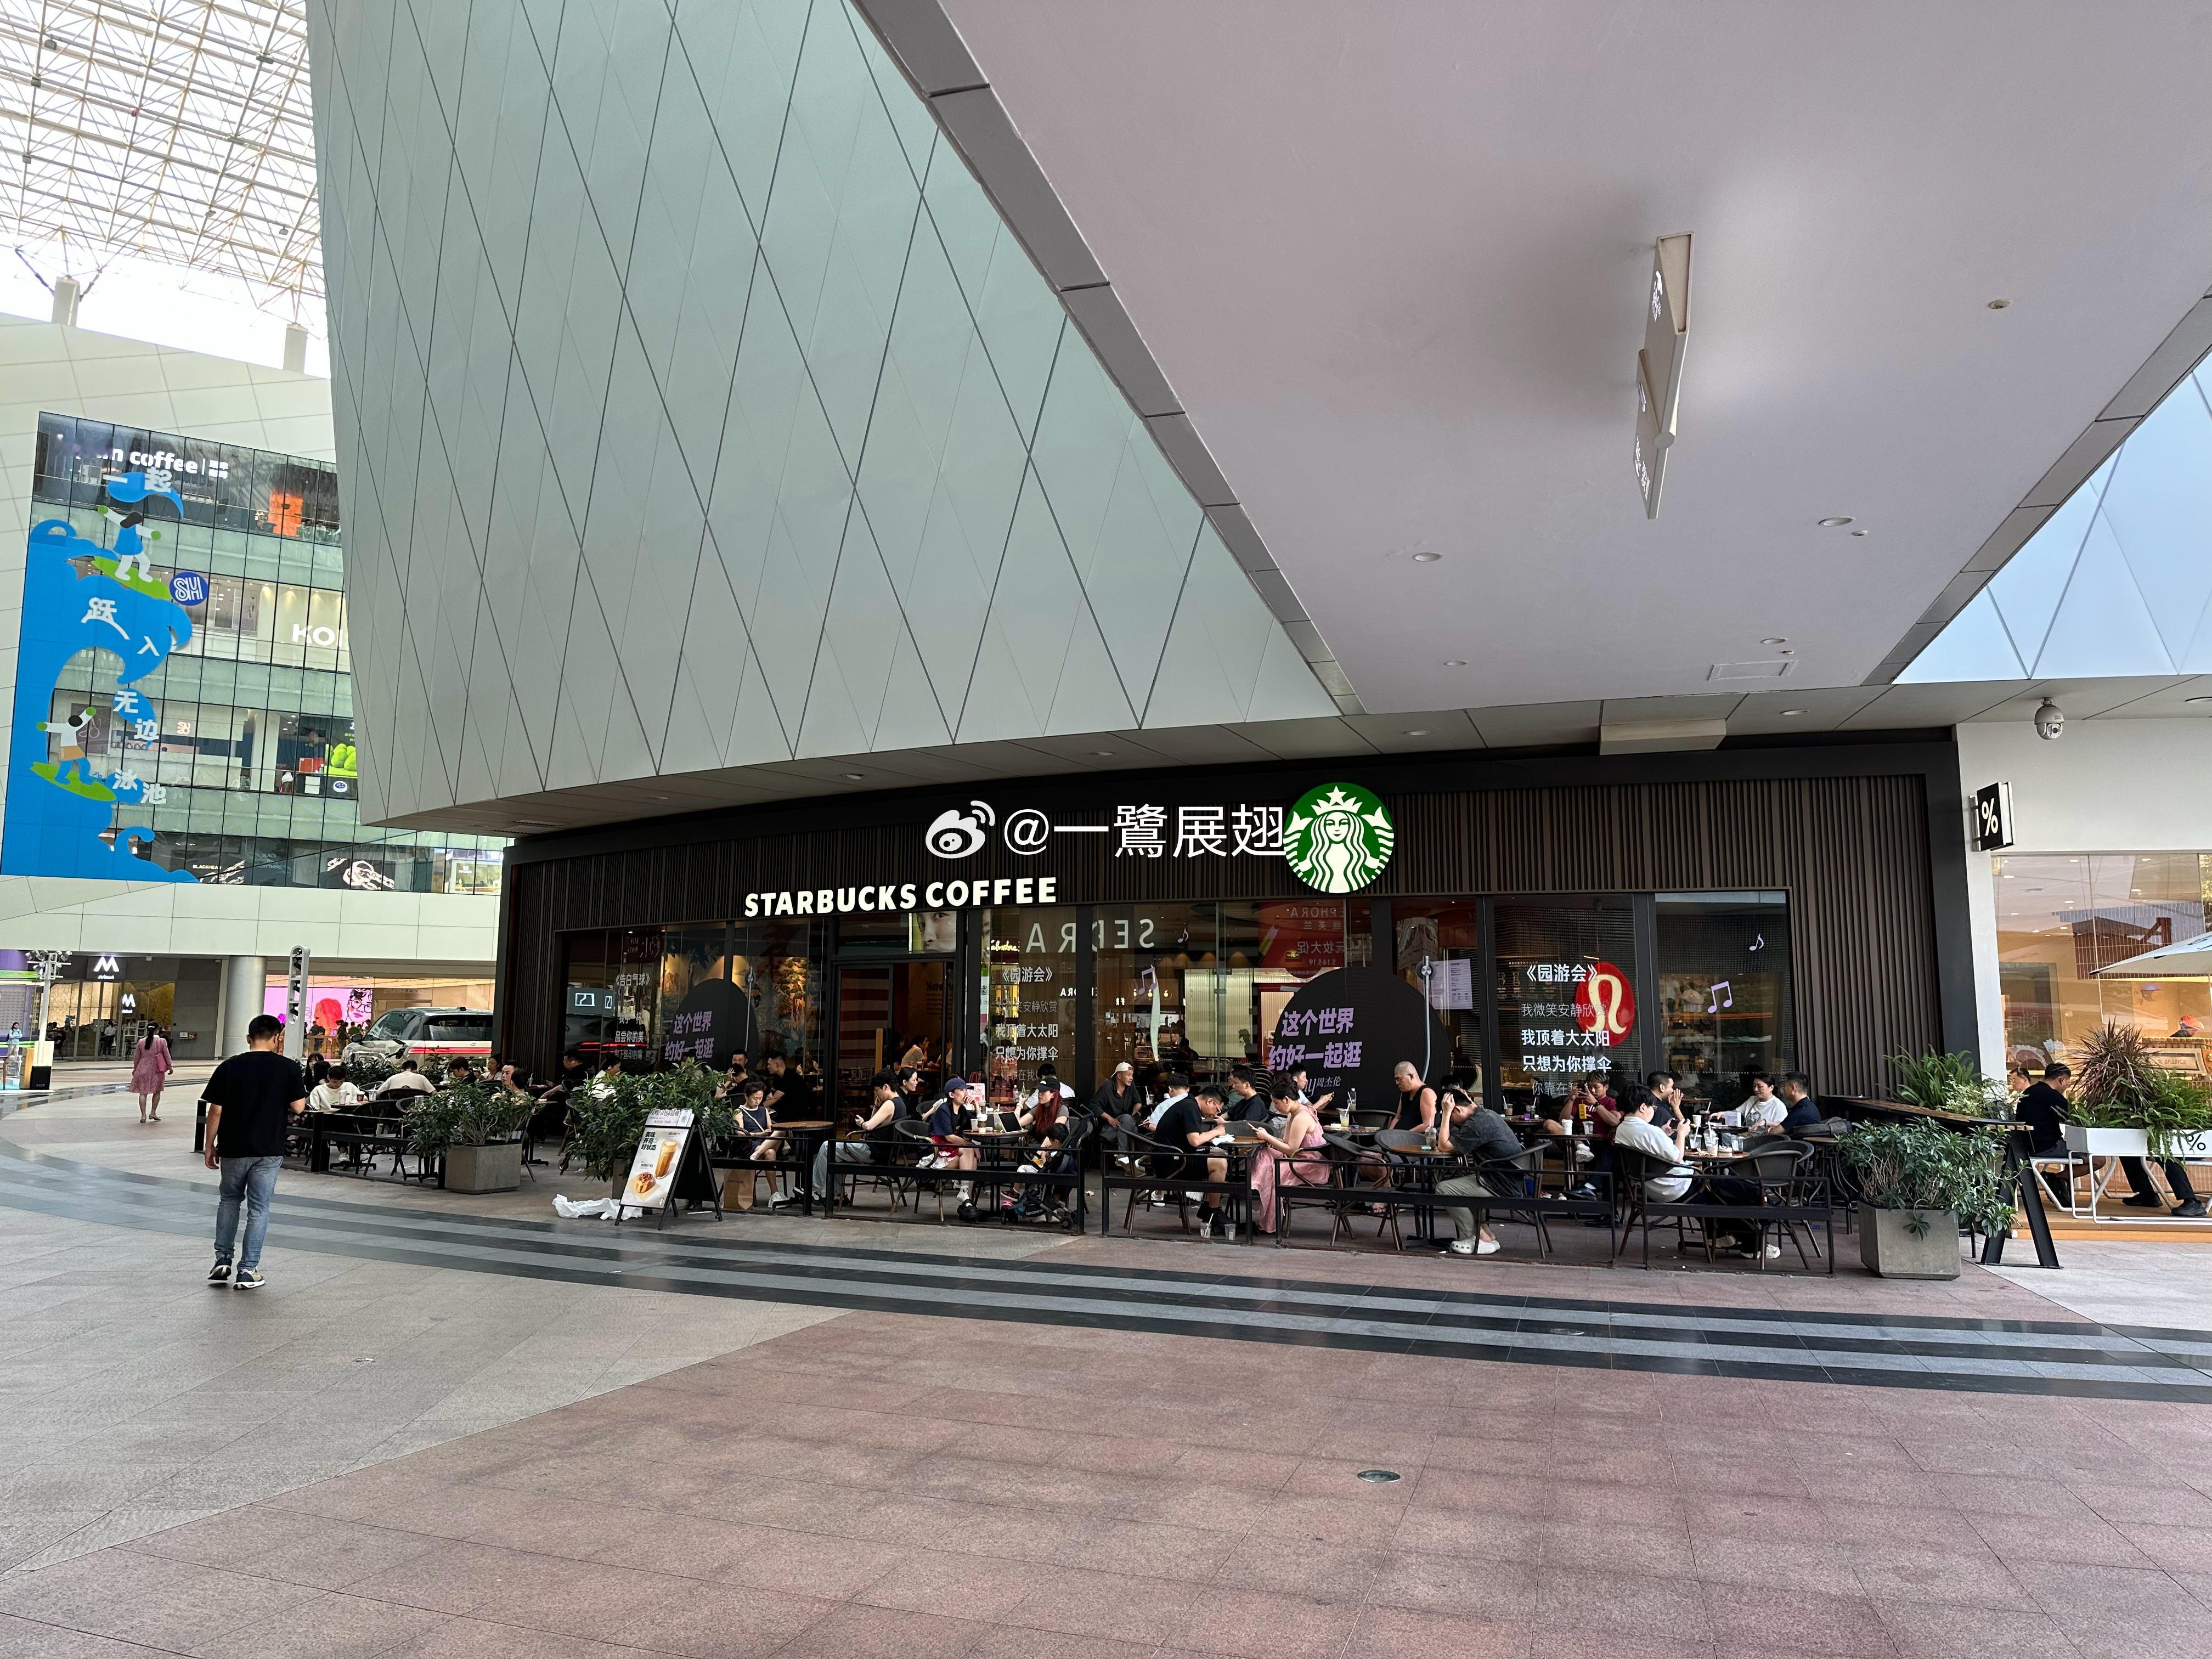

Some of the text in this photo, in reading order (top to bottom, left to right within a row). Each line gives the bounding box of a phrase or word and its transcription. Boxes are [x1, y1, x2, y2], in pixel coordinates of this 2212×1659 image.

[129, 451, 198, 474] coffee
[112, 768, 167, 805] 泳池
[744, 877, 1057, 917] STARBUCKS COFFEE
[616, 973, 650, 986] 《告白气球》
[1002, 966, 1053, 983] 《园游会》
[1526, 963, 1598, 982] 《园游会》
[1521, 1003, 1607, 1018] 我微笑安静欣赏
[673, 1011, 712, 1035] 这个世界
[996, 1023, 1058, 1038] 我顶着大太阳
[1281, 1007, 1355, 1037] 这个世界
[1521, 1029, 1610, 1047] 我顶着大太阳
[664, 1037, 715, 1062] 约好一起逛
[996, 1045, 1059, 1062] 只想为你撑伞
[1267, 1041, 1363, 1071] 约好一起逛
[1522, 1055, 1612, 1073] 只想为你撑伞
[1317, 1075, 1342, 1088] 周杰伦
